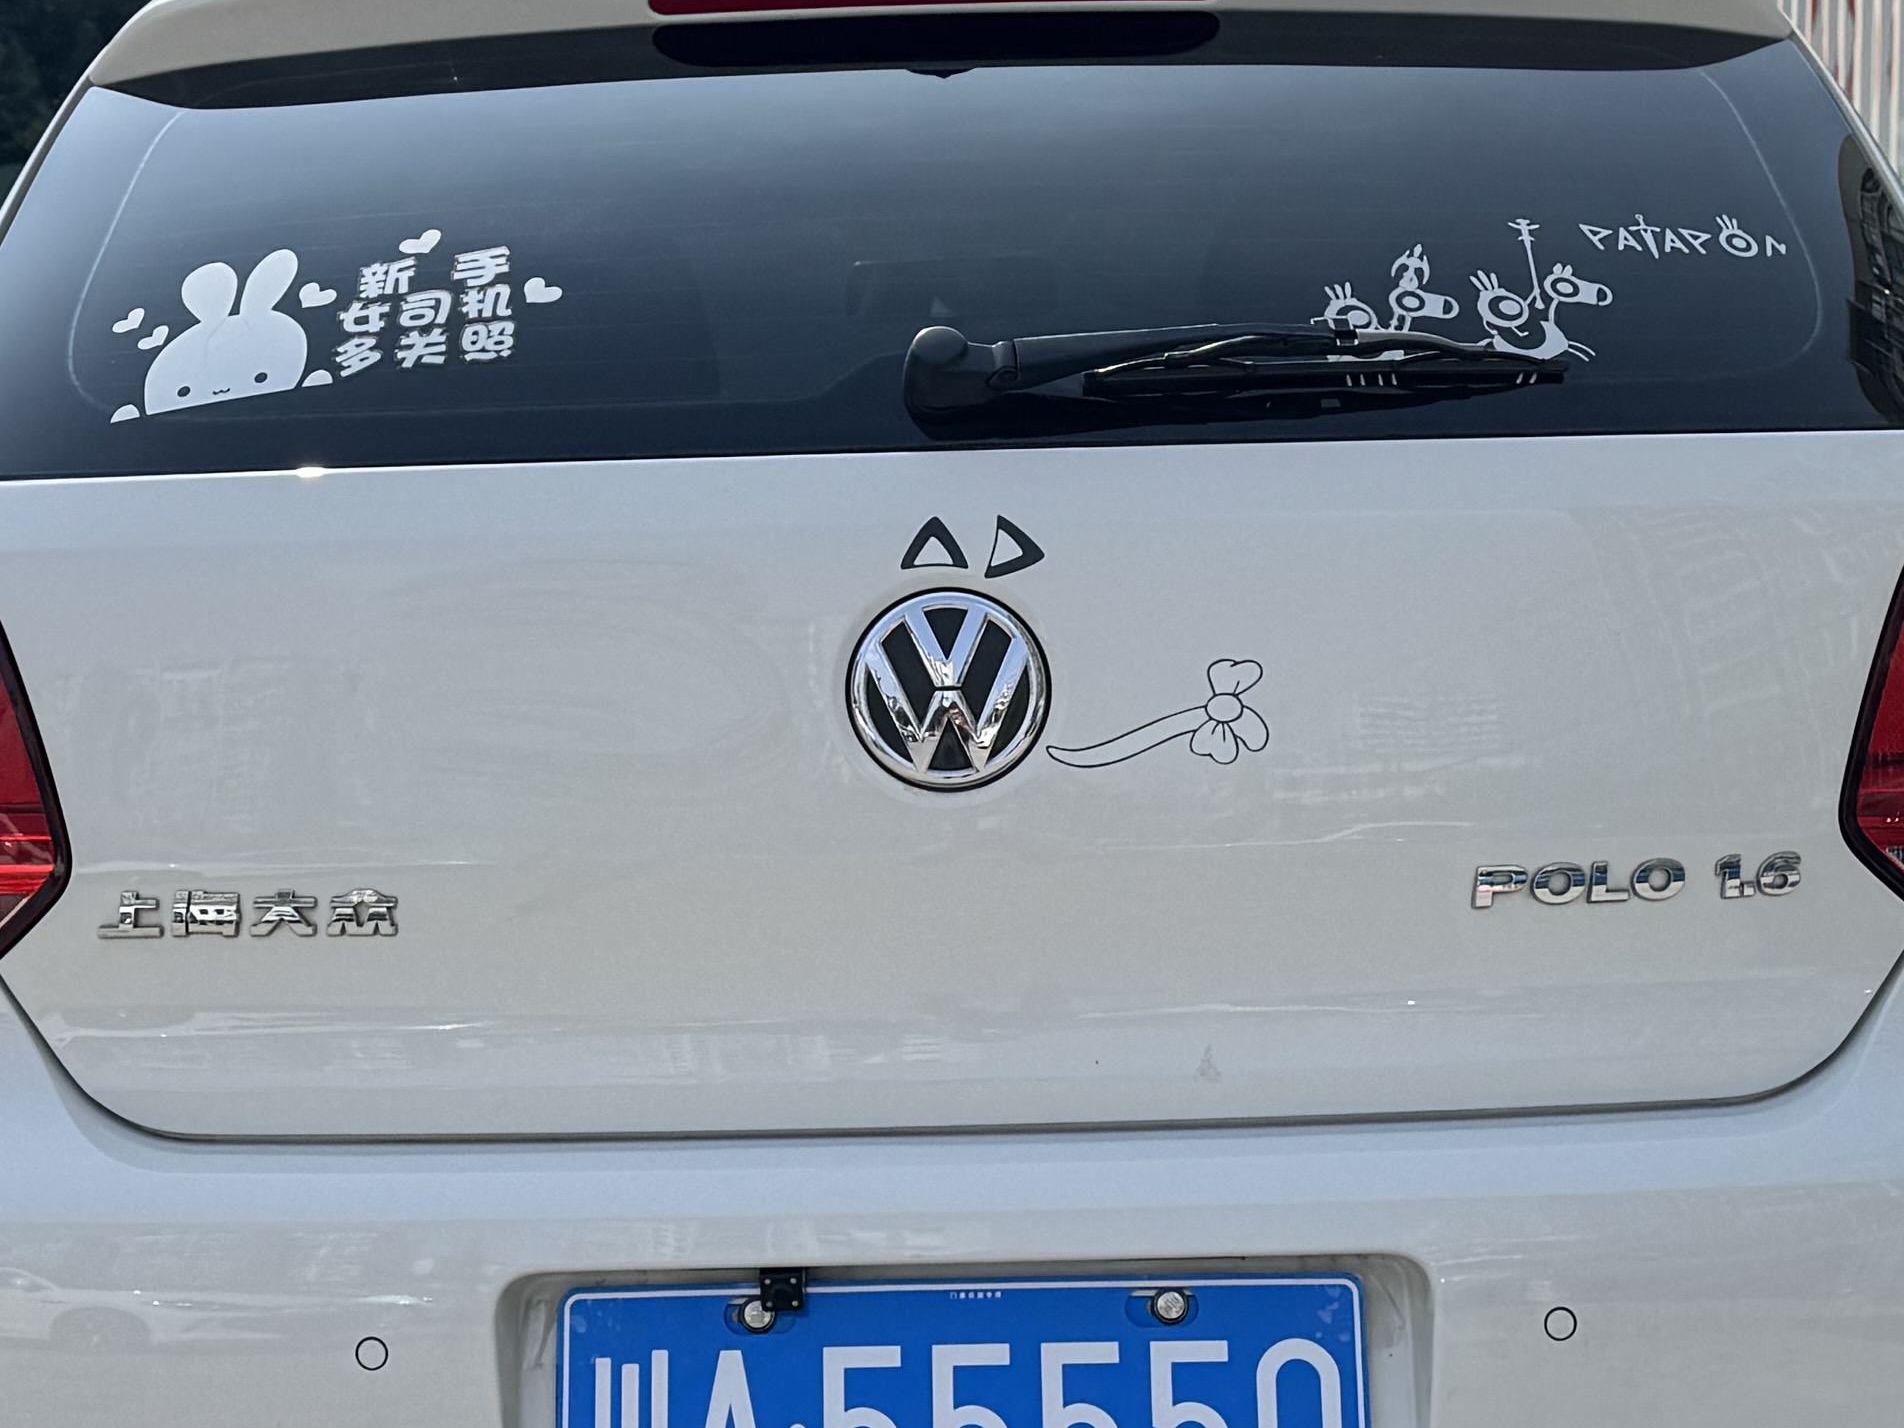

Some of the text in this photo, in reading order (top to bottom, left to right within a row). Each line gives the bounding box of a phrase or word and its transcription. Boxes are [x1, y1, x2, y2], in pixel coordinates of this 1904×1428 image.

[1579, 214, 1786, 259] PATAPON
[360, 246, 511, 299] 新手
[338, 283, 512, 334] 女司机
[334, 320, 516, 378] 多关照
[1471, 851, 1802, 910] POLO 1.6
[97, 888, 398, 940] 上海大众
